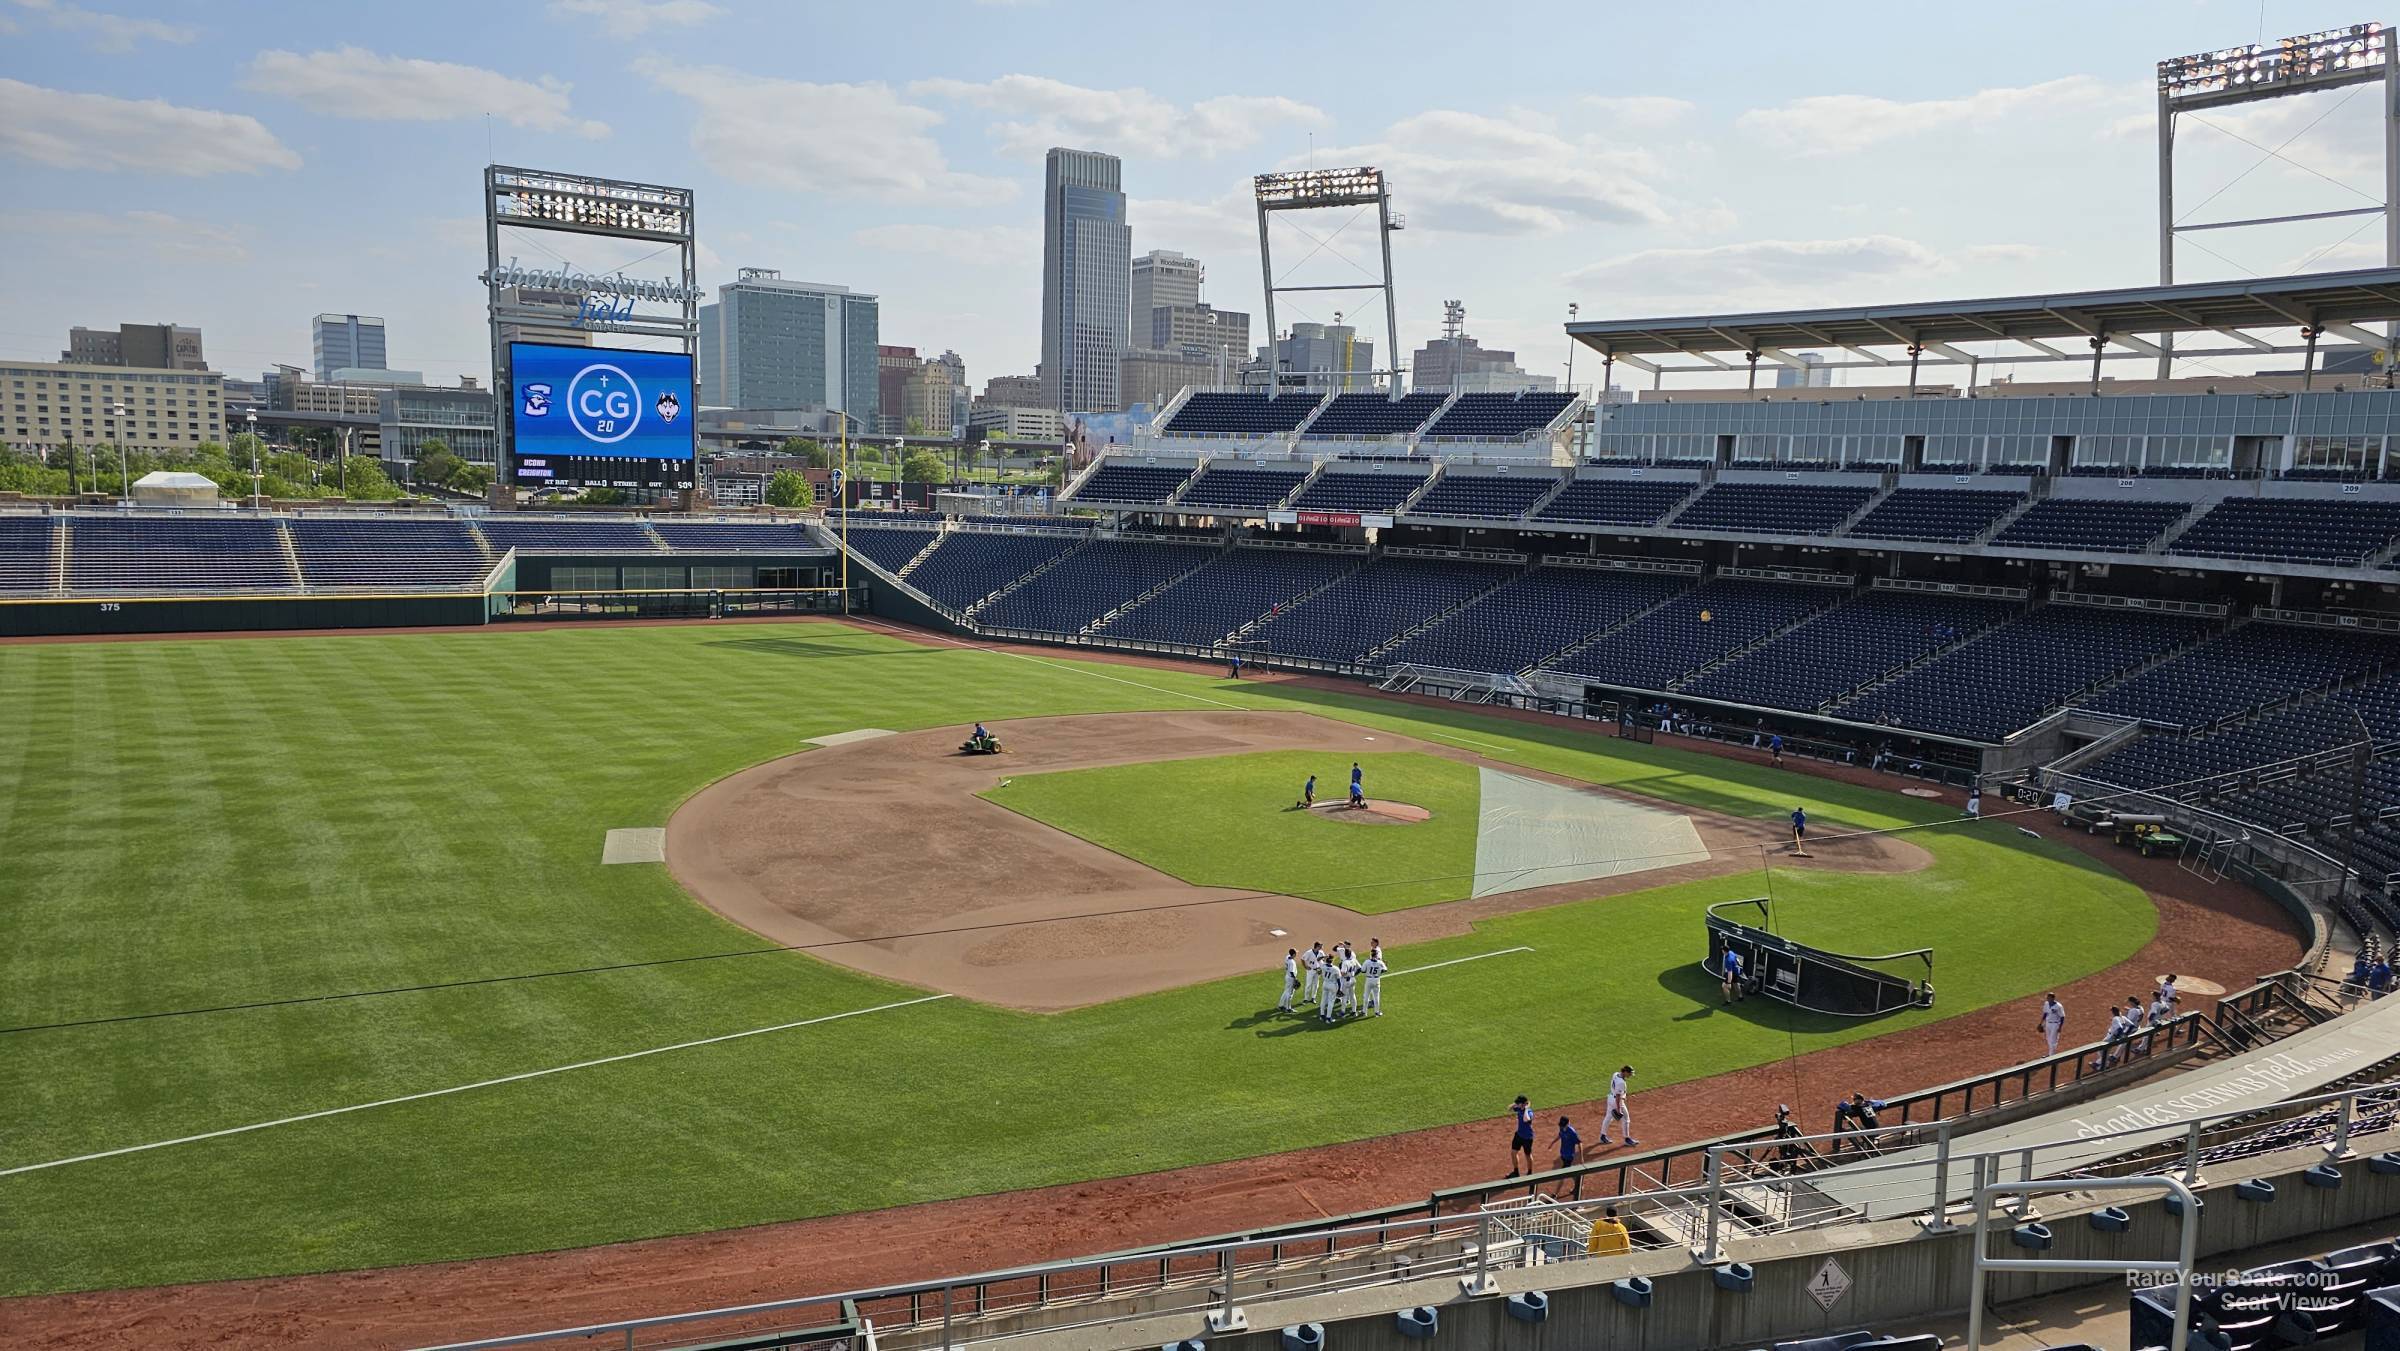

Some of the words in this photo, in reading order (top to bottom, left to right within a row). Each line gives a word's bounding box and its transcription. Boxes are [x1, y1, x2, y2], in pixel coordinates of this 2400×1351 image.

[490, 256, 597, 293] charles
[570, 297, 636, 327] field
[583, 321, 630, 333] OMAHA
[580, 389, 630, 419] CG
[597, 420, 614, 433] 20
[518, 468, 552, 477] CREIGHTON
[662, 463, 667, 471] 0
[674, 463, 679, 471] 0
[100, 603, 120, 611] 375
[2018, 788, 2038, 803] 0:20
[1370, 967, 1378, 975] 15
[2072, 1104, 2179, 1145] charles
[2174, 1077, 2269, 1114] SCHWAB
[2244, 1053, 2313, 1092] field
[2309, 1047, 2363, 1068] OMAHA
